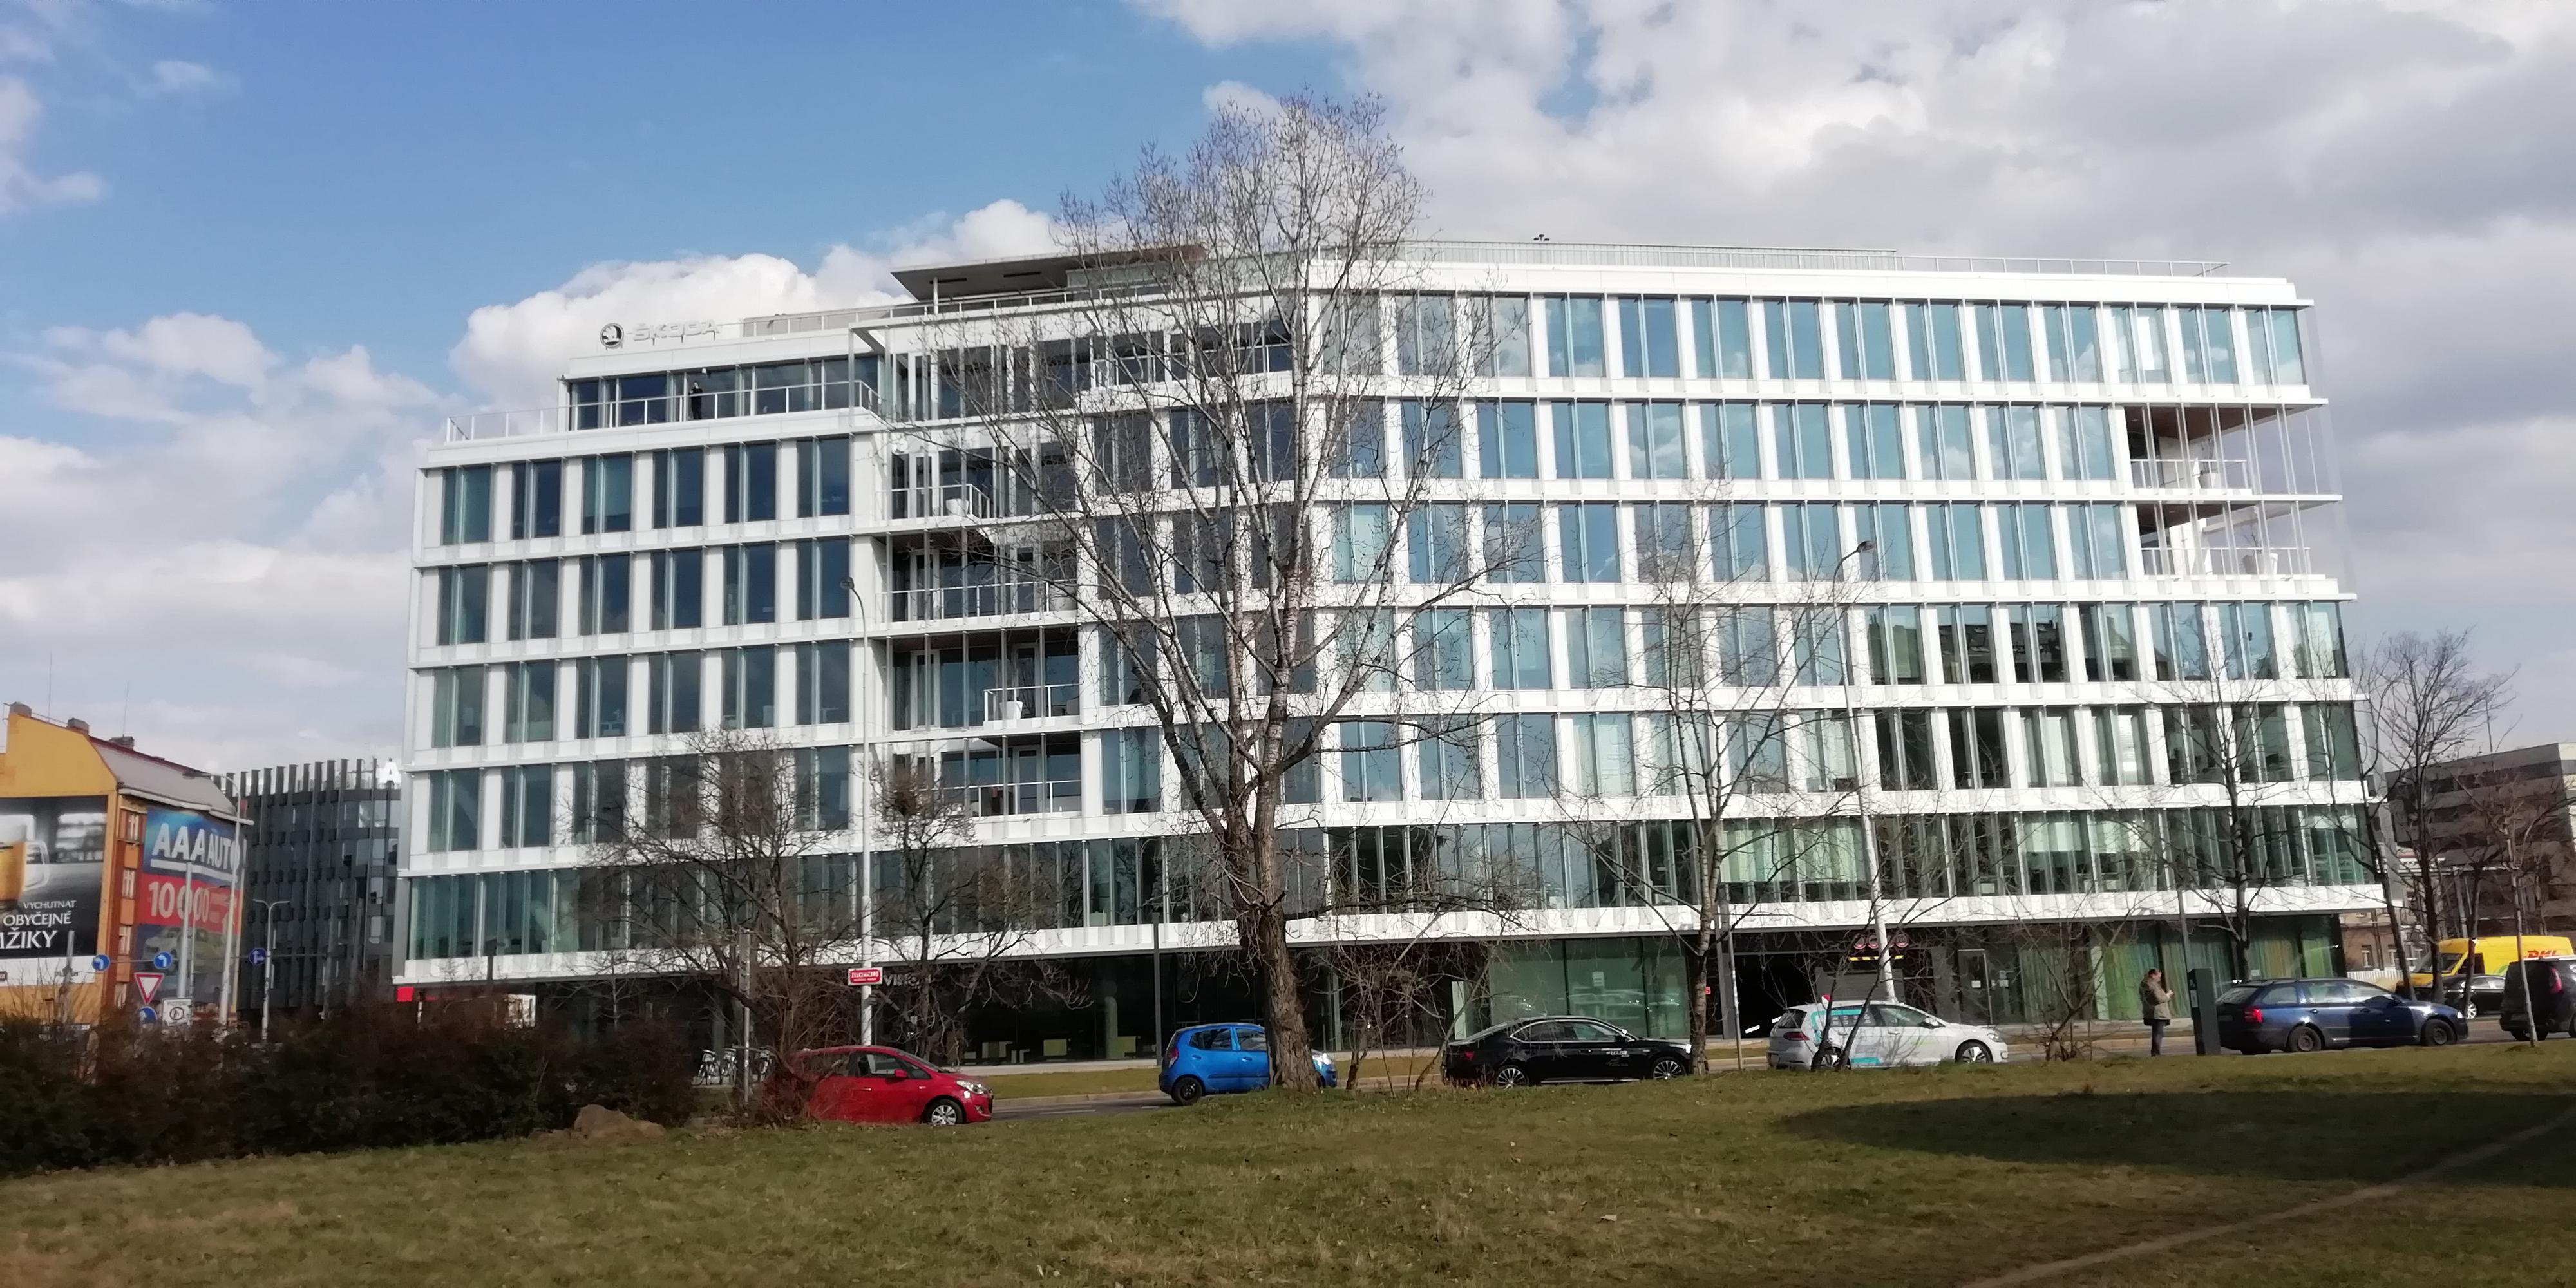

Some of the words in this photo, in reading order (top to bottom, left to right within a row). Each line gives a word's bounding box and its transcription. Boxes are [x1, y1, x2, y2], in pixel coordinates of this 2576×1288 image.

[152, 823, 205, 862] AAA
[207, 833, 240, 869] AUTO
[23, 900, 77, 909] VYCHUTNAT
[3, 911, 72, 928] OBYČEJNÉ
